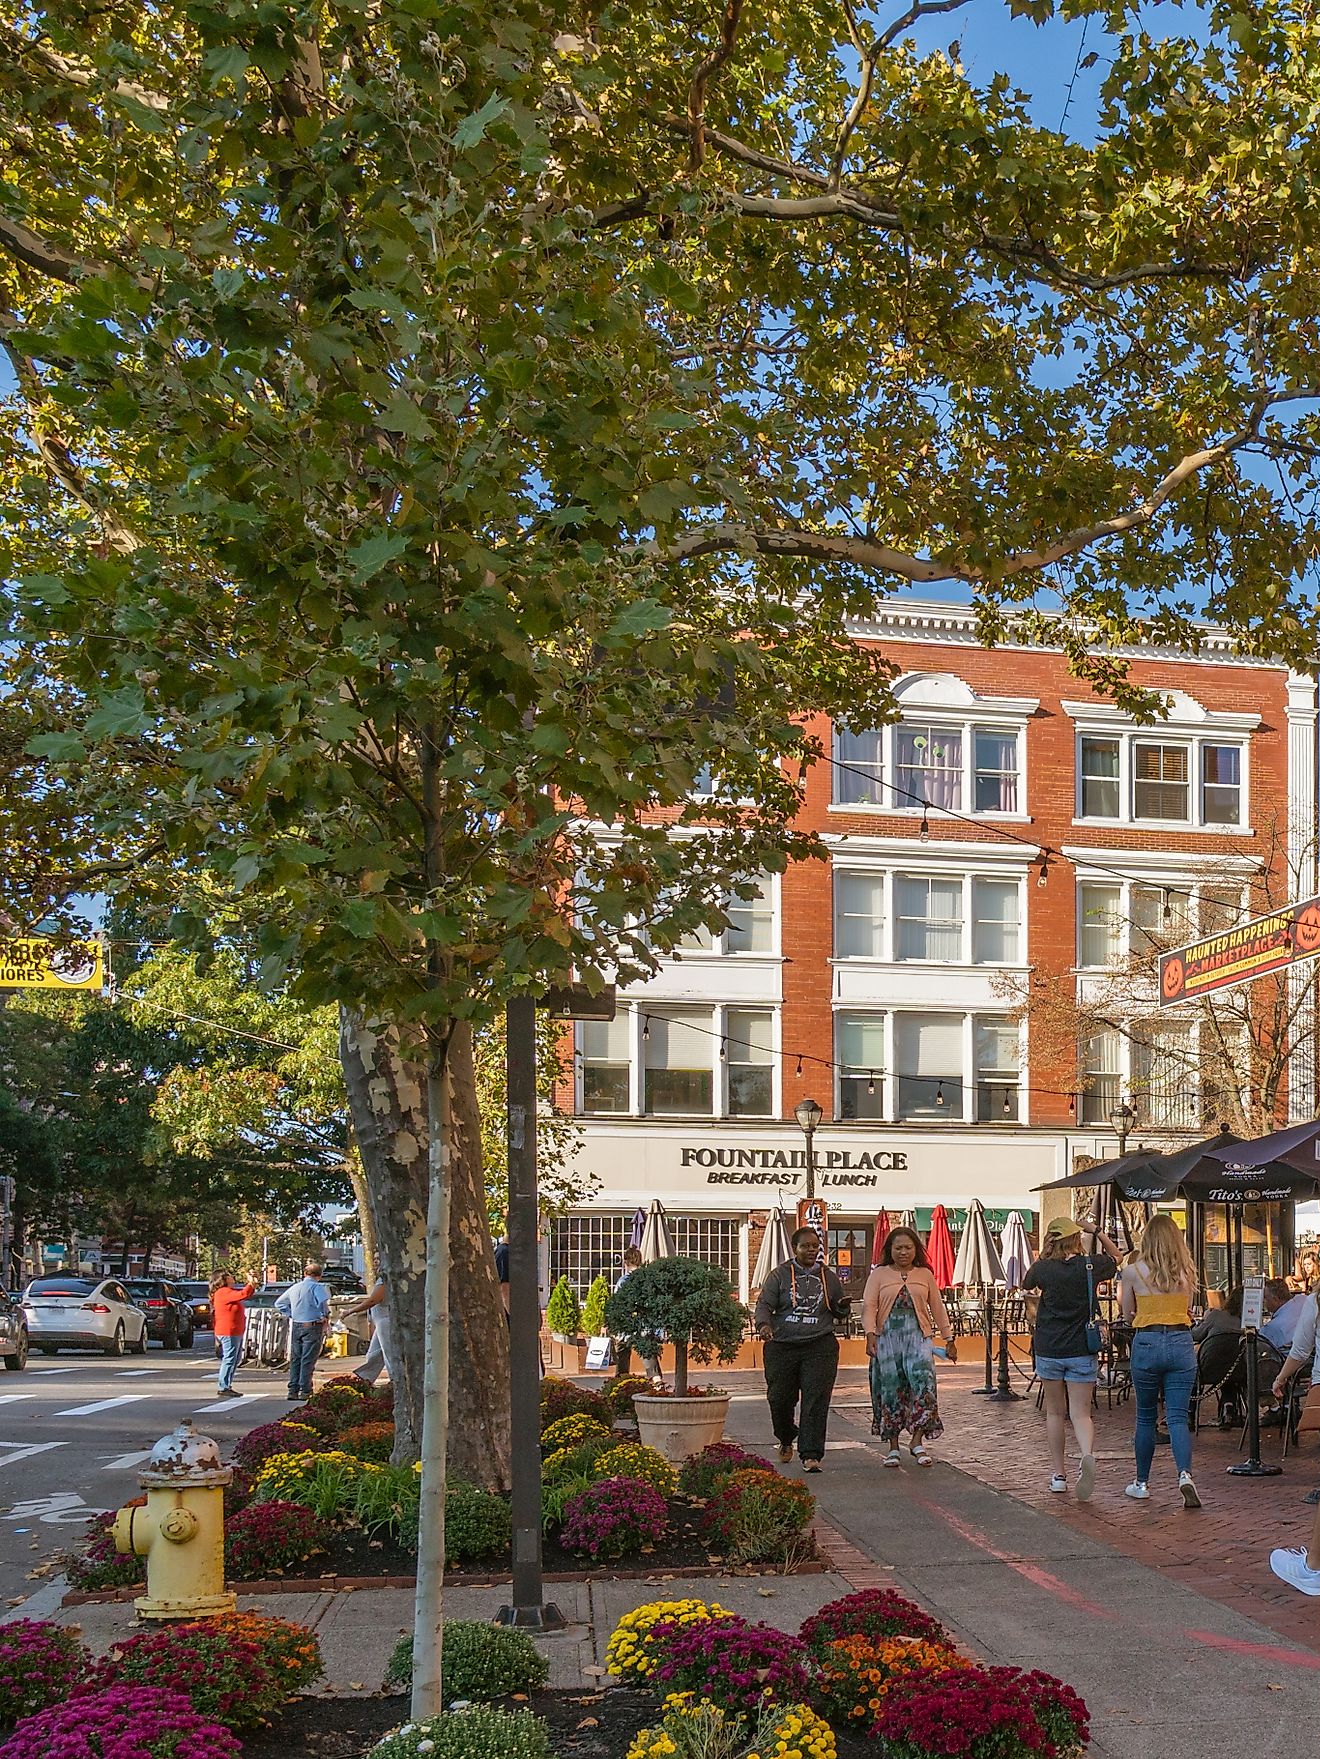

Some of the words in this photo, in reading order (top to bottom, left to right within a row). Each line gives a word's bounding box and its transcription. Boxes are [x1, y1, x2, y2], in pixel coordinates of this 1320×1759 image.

[1185, 936, 1228, 963] HAUNTED
[1229, 911, 1295, 947] HAPPENINGS
[1201, 936, 1275, 973] MARKETPLACE
[680, 1147, 820, 1169] FOUNTAIN
[826, 1150, 909, 1172] PLACE
[707, 1172, 803, 1186] BREAKFAST
[822, 1173, 878, 1188] LUNCH
